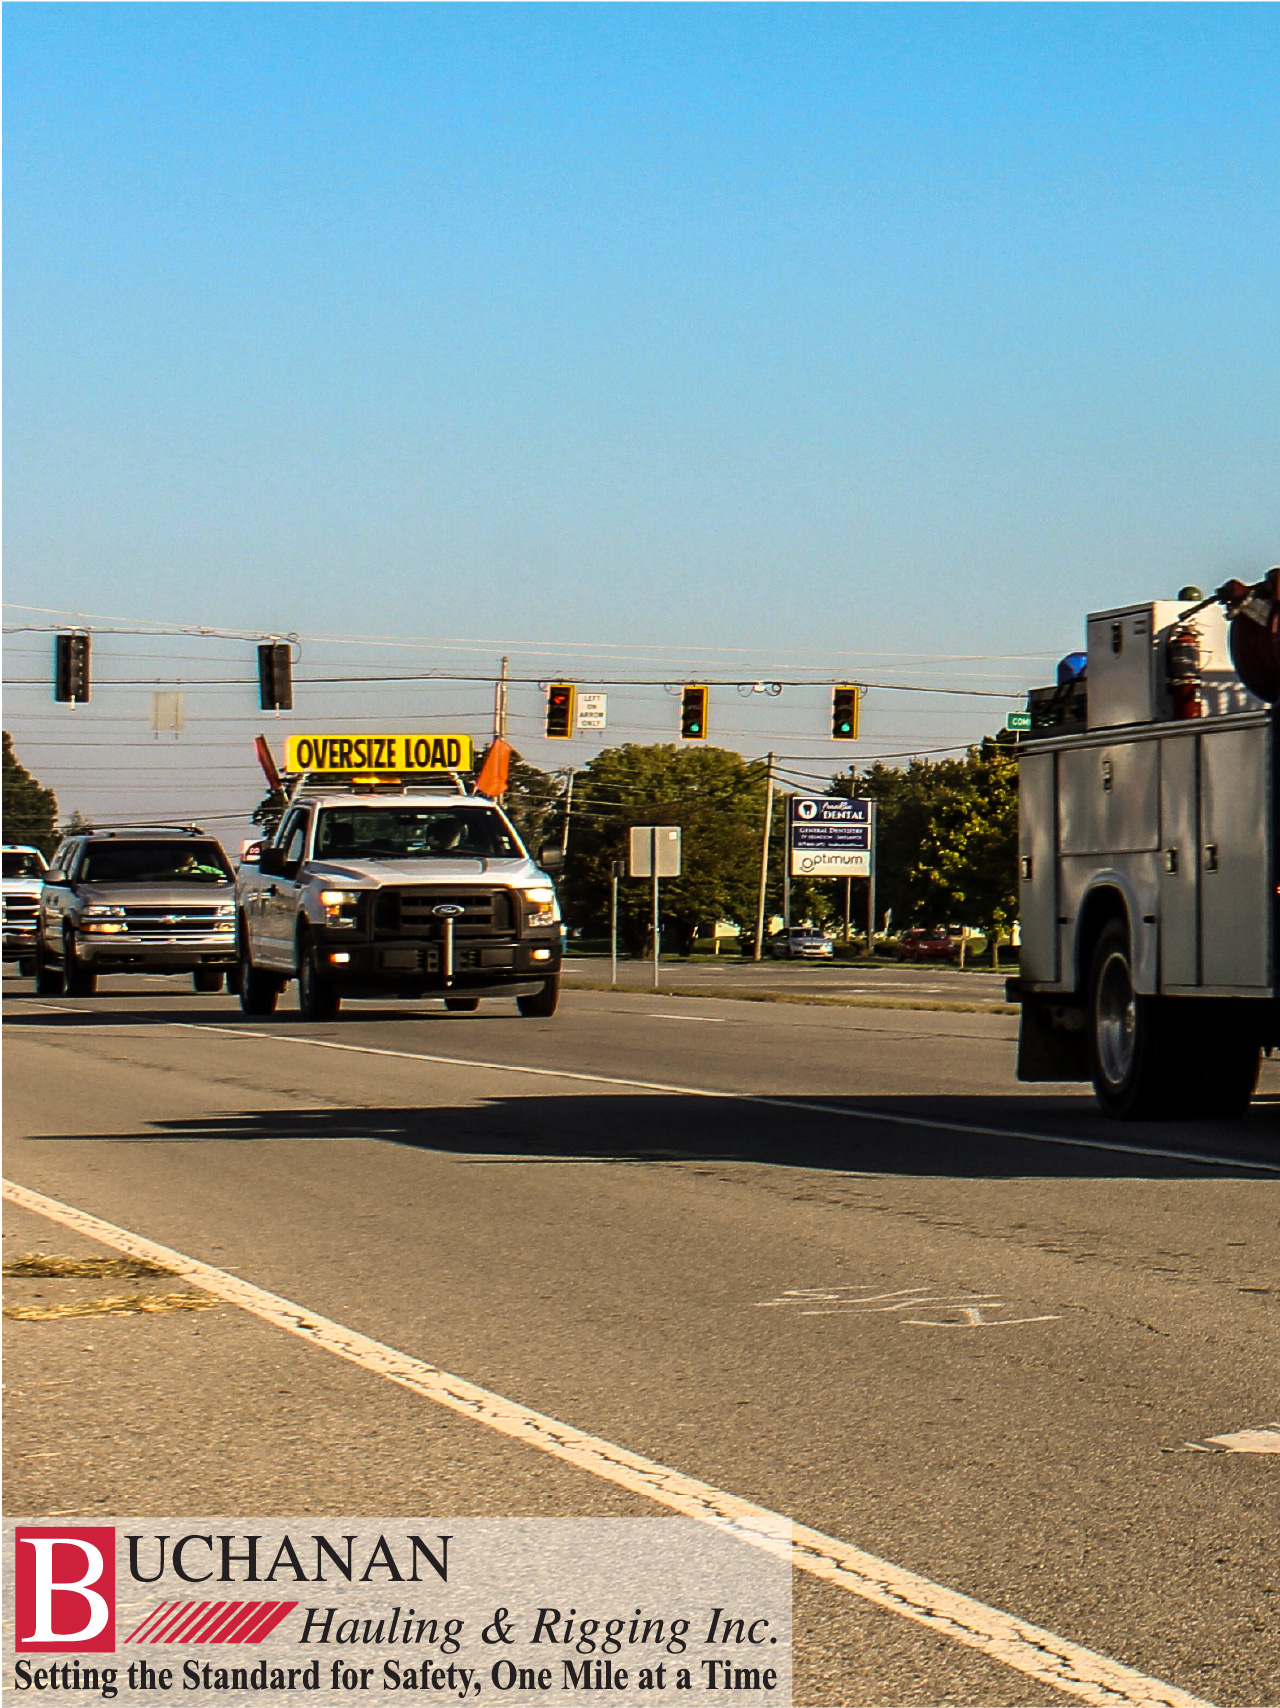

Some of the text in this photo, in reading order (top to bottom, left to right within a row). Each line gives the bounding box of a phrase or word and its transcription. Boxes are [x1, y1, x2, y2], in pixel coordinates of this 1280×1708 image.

[296, 738, 462, 769] OVERSIZE LOAD
[823, 811, 865, 820] DENTAL
